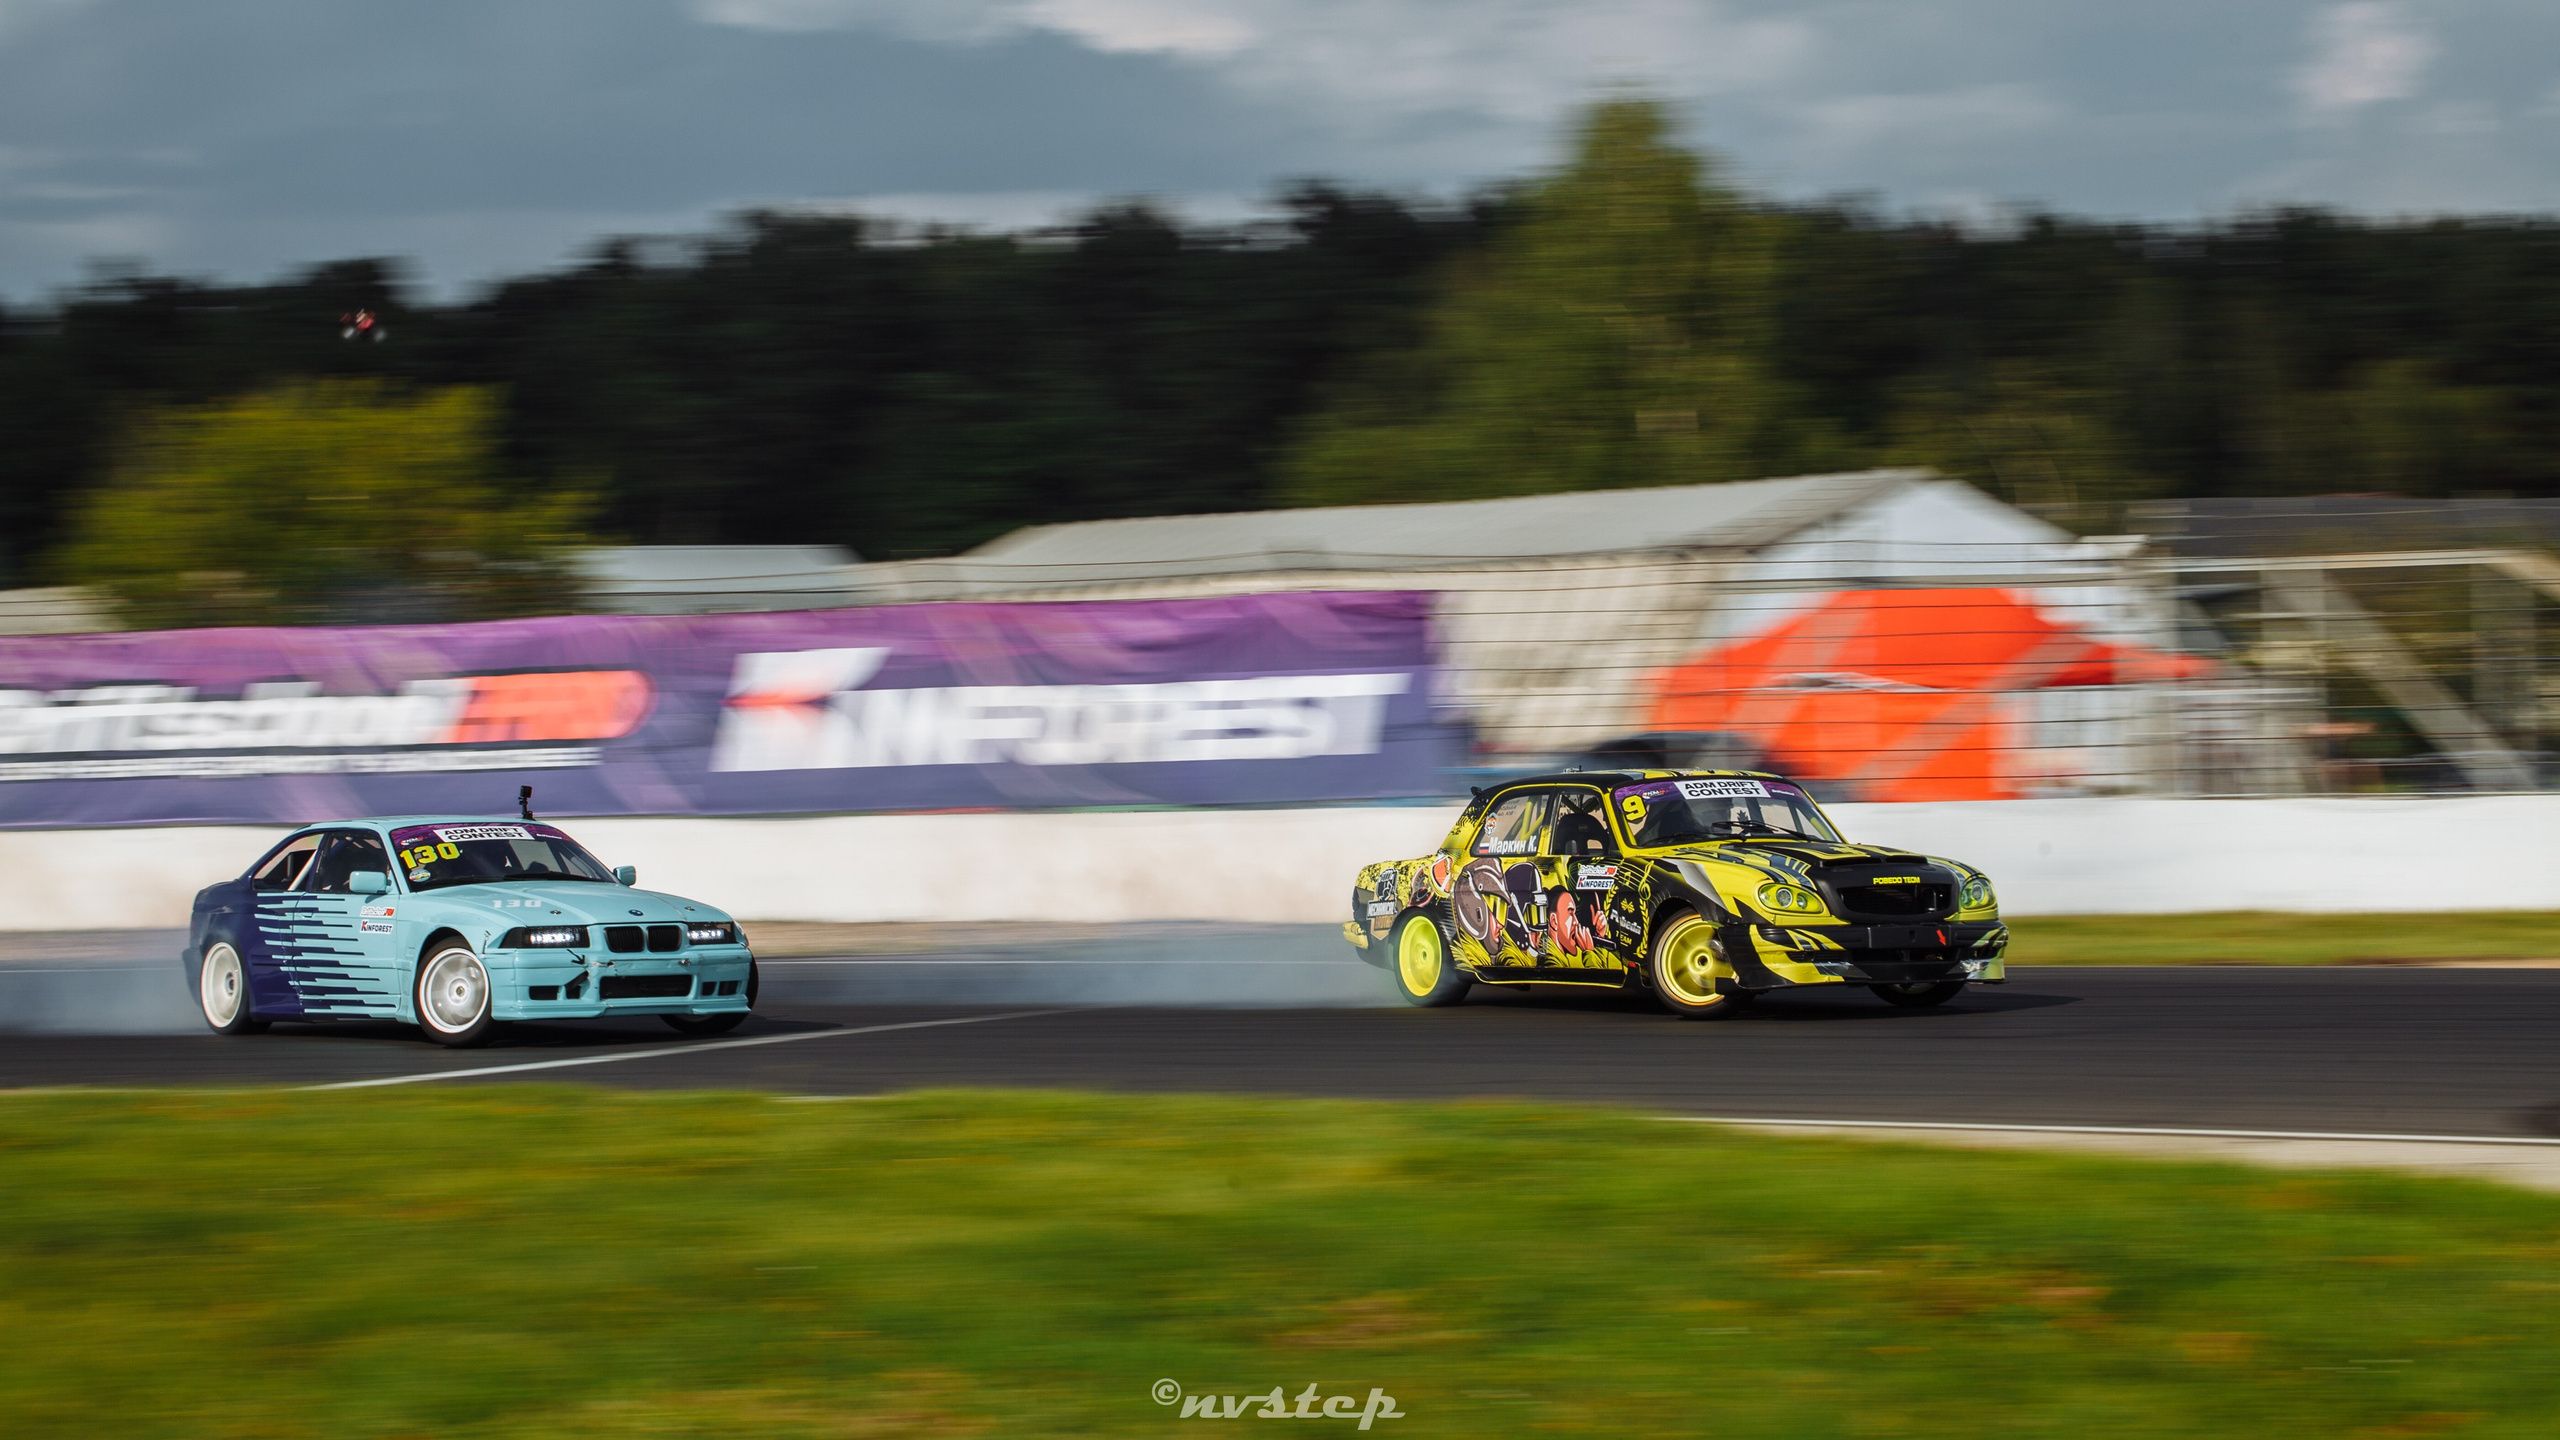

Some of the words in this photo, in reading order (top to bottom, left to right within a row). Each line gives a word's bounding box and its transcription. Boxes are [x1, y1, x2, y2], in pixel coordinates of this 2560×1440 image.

[1688, 787, 1760, 797] CONTEST
[1621, 793, 1648, 822] 9
[444, 828, 477, 836] ADM
[448, 832, 523, 841] CONTEST
[1488, 837, 1527, 855] Маркин
[400, 842, 460, 869] 130
[1578, 877, 1613, 888] KINFOREST
[492, 899, 542, 909] 130
[361, 921, 393, 932] KINFOREST
[1616, 930, 1632, 945] TEAM
